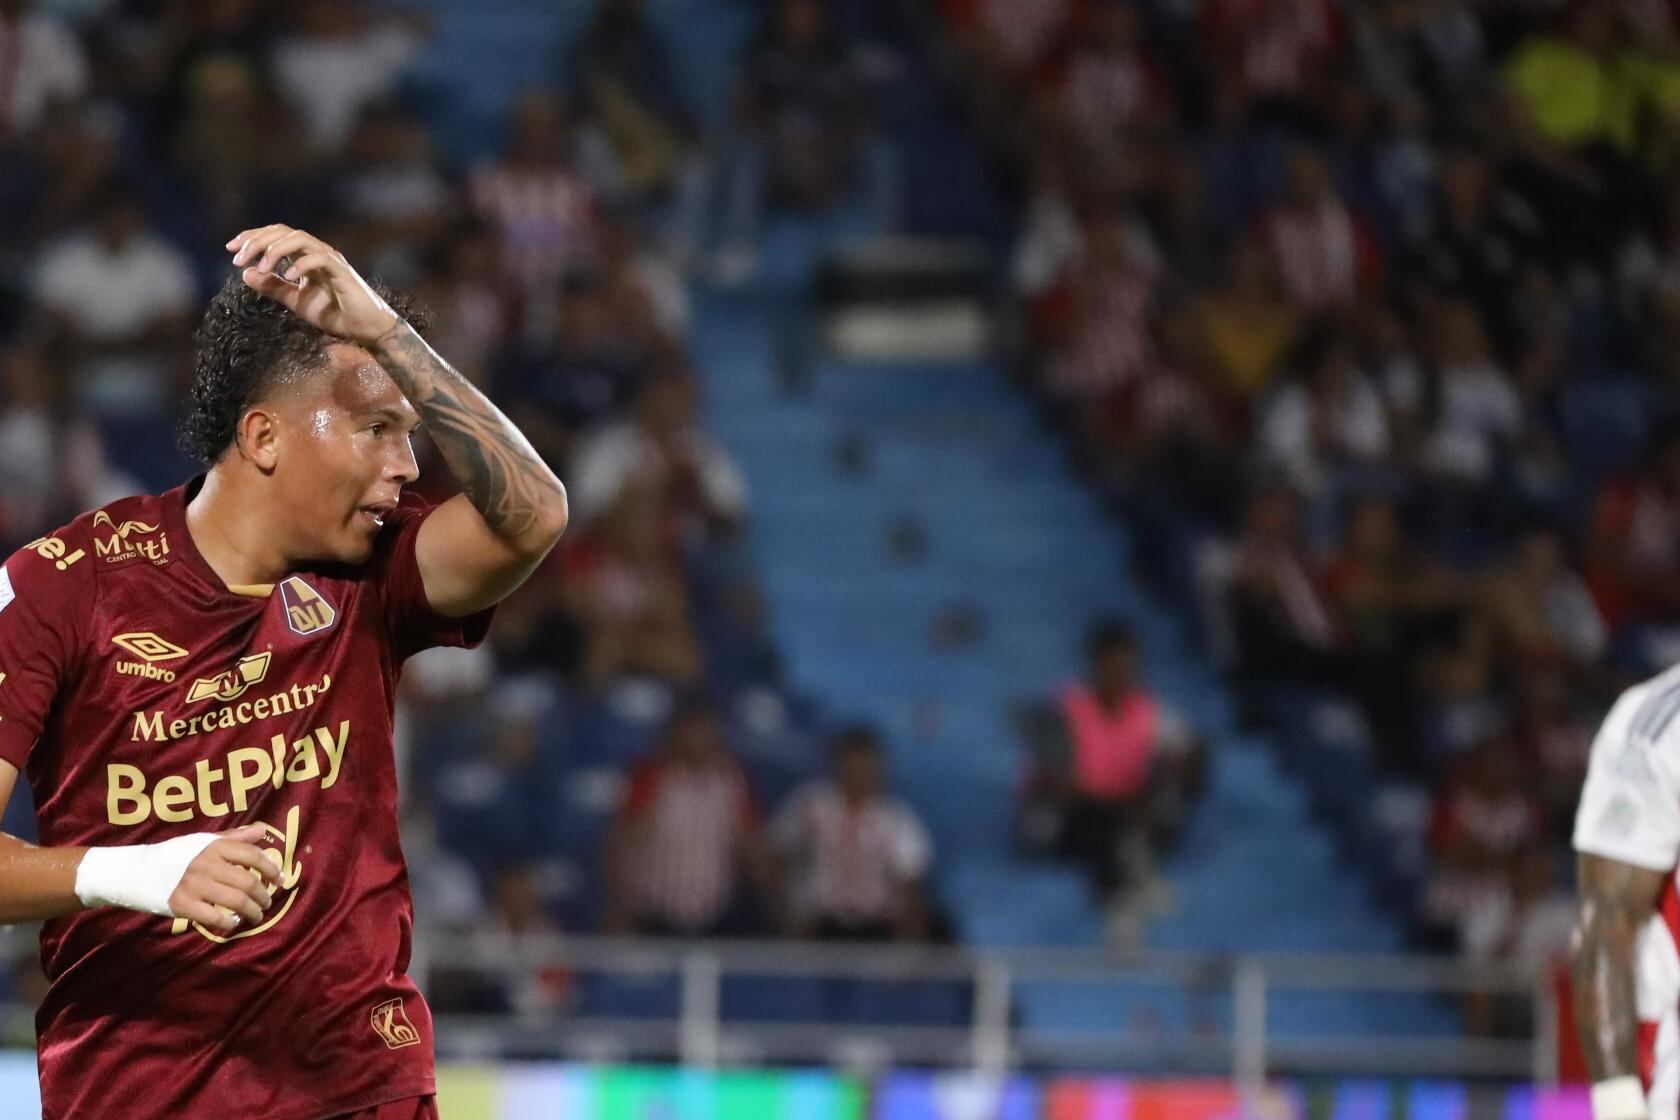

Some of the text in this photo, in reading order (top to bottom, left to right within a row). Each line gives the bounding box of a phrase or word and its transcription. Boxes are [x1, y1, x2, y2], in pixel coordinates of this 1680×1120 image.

[116, 660, 176, 684] umbro
[131, 673, 331, 742] Mercacentro
[107, 719, 350, 826] BetPlay
